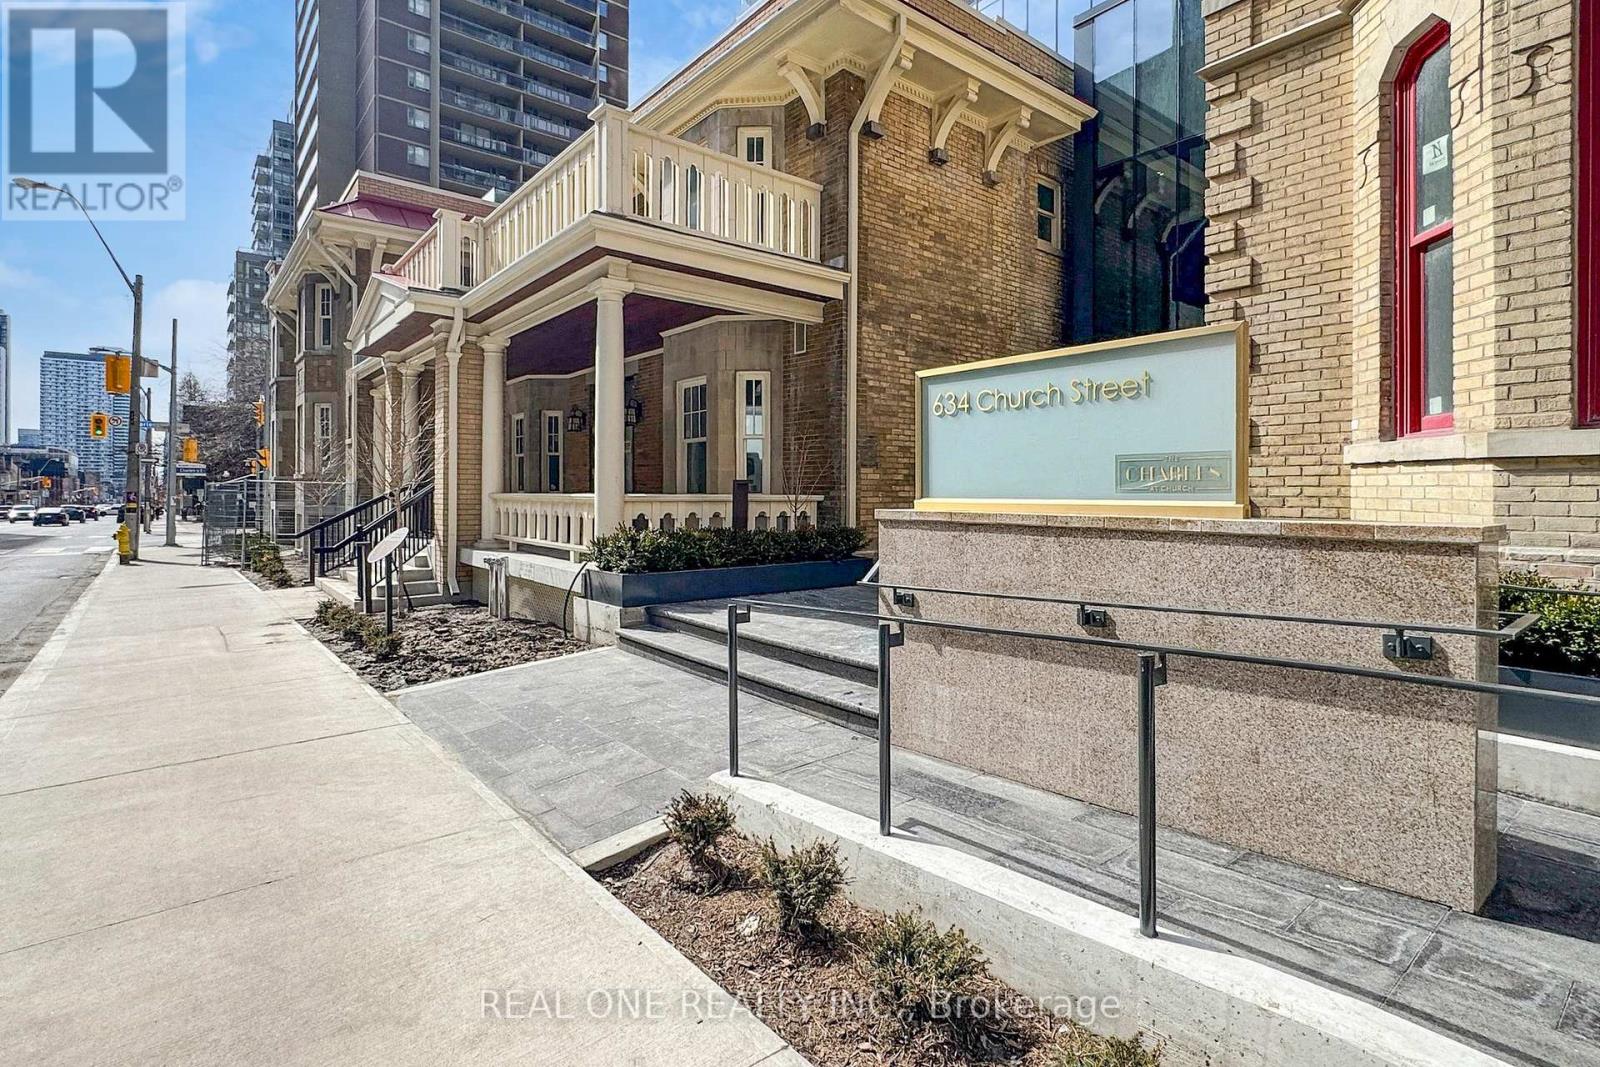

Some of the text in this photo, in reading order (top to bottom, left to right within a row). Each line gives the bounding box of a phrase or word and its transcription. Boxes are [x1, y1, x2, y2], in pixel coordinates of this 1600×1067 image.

[932, 370, 1153, 417] 634 Church Street
